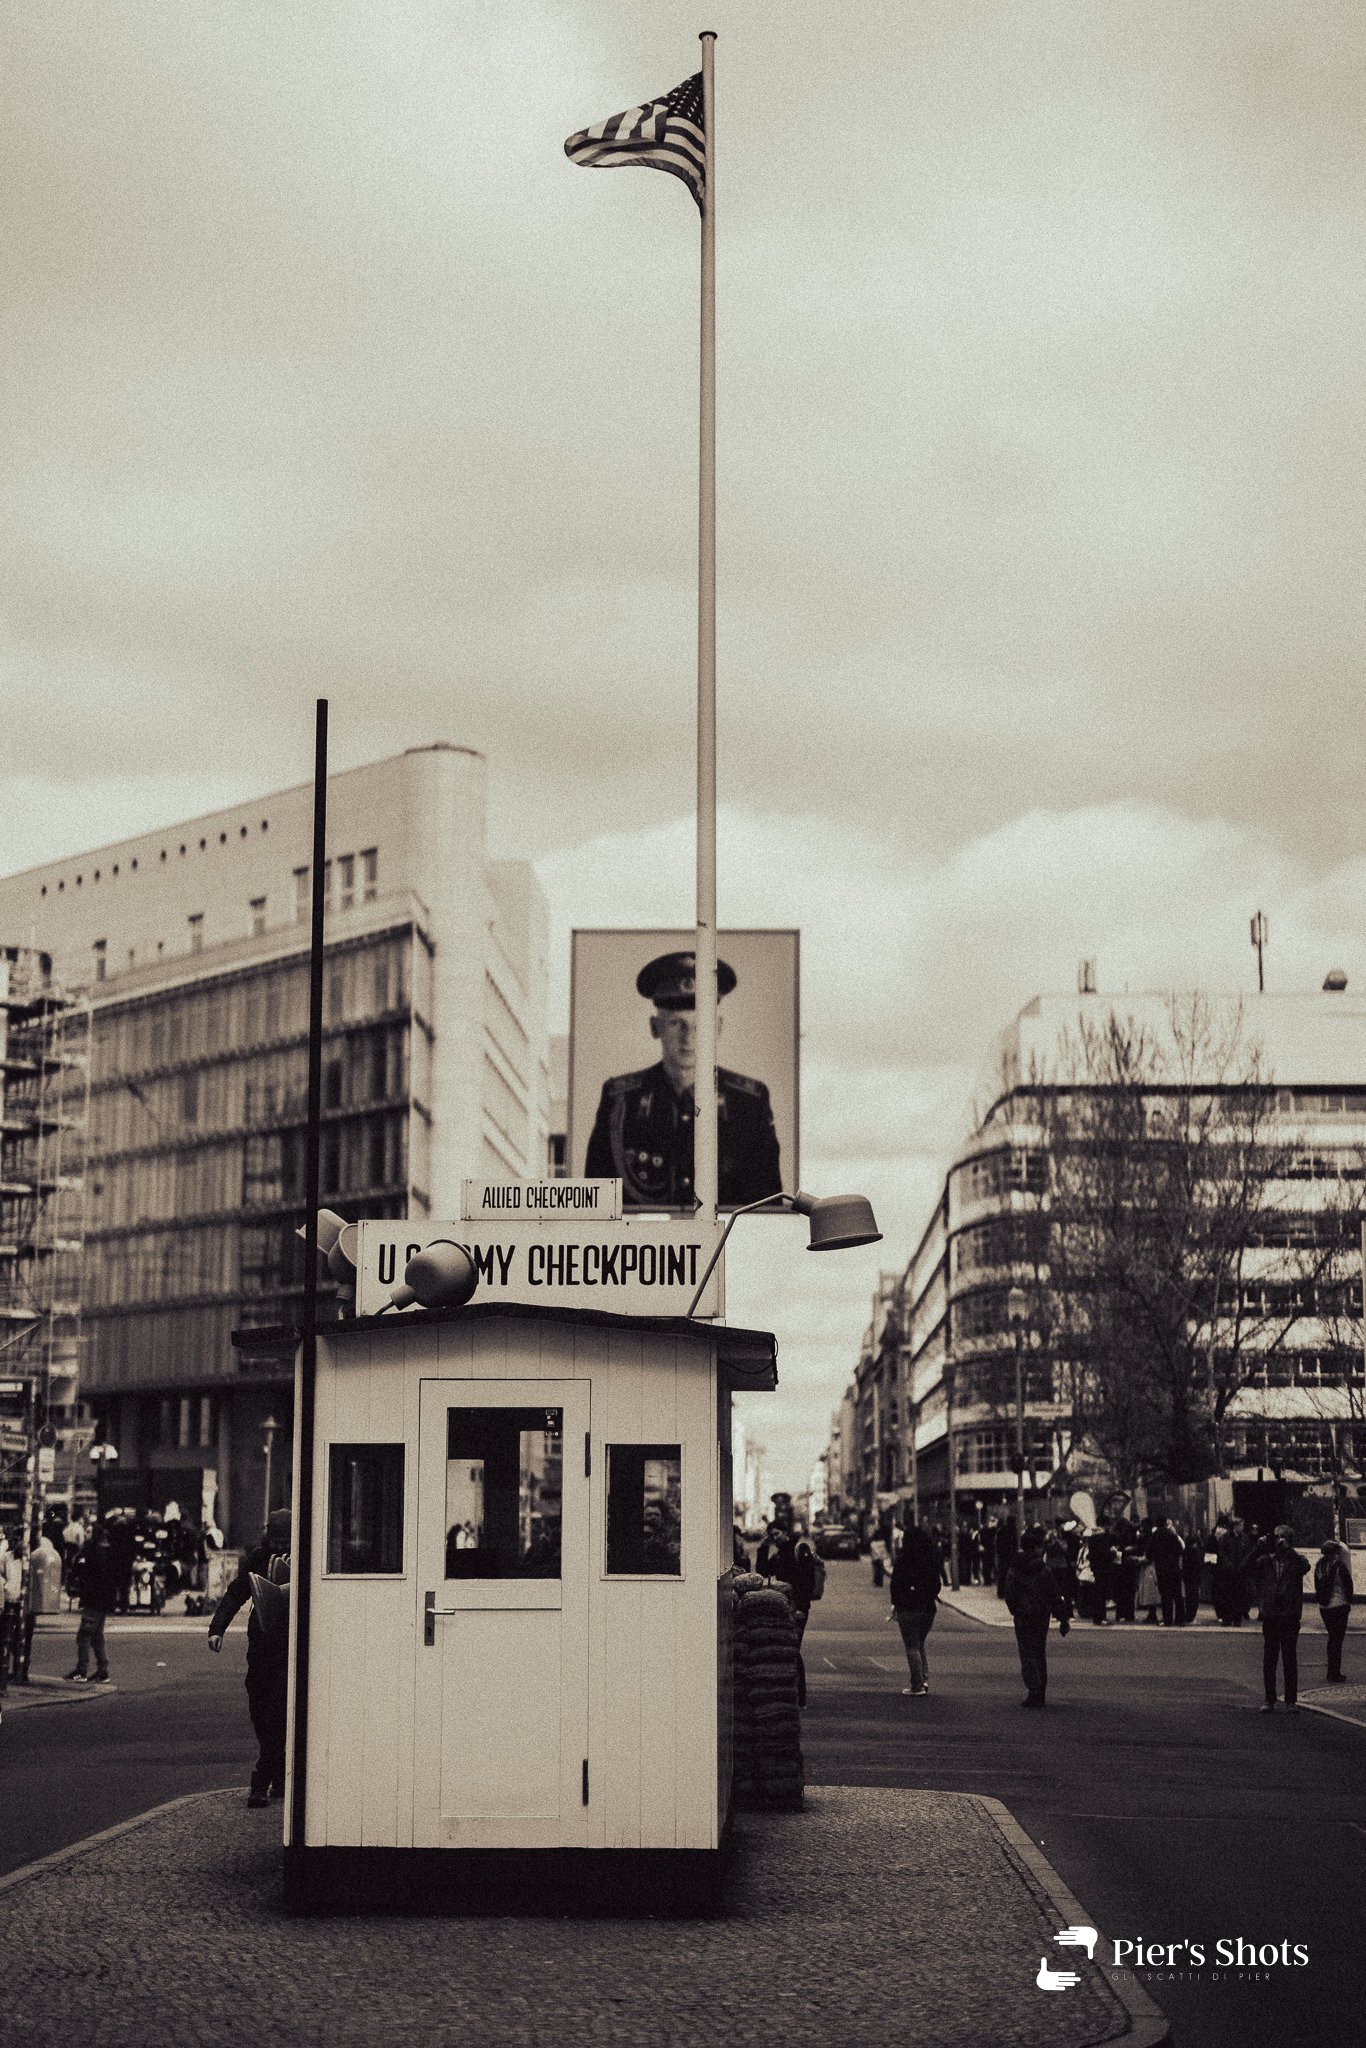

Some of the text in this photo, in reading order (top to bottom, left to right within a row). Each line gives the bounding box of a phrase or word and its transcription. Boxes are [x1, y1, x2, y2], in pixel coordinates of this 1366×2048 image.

[482, 1187, 600, 1208] ALLIED CHECKPOINT
[462, 1244, 516, 1286] MY
[528, 1244, 701, 1286] CHECKPOINT
